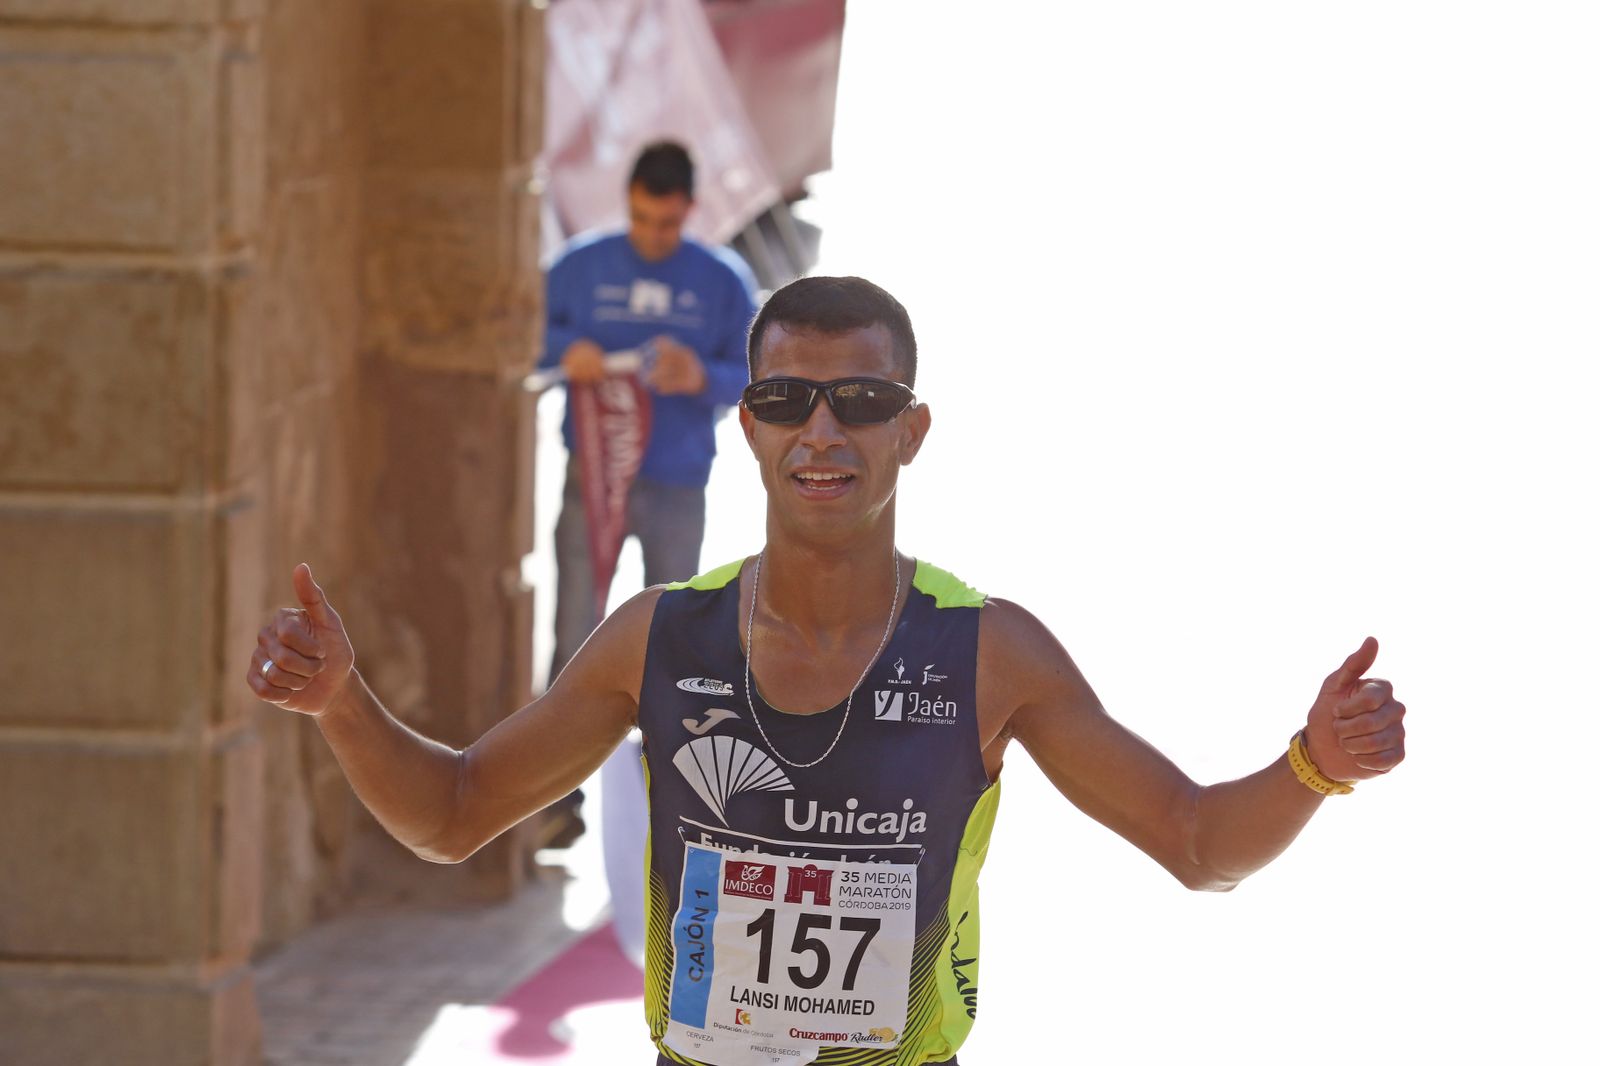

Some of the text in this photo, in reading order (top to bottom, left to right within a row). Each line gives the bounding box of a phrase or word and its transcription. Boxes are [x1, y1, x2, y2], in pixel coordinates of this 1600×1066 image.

[908, 692, 956, 717] Jaén
[785, 798, 927, 843] Unicaja
[805, 870, 817, 878] 35
[841, 871, 912, 885] 35 MEDIA
[725, 879, 774, 896] IMDECO
[839, 885, 912, 899] MARATÓN
[683, 889, 710, 983] CAJÓN 1
[747, 908, 882, 991] 157
[730, 985, 875, 1016] LANSI MOHAMED
[686, 1030, 714, 1042] CERVEZA
[789, 1027, 848, 1042] Cruzcampo
[750, 1045, 801, 1057] FRUTOS SECOS
